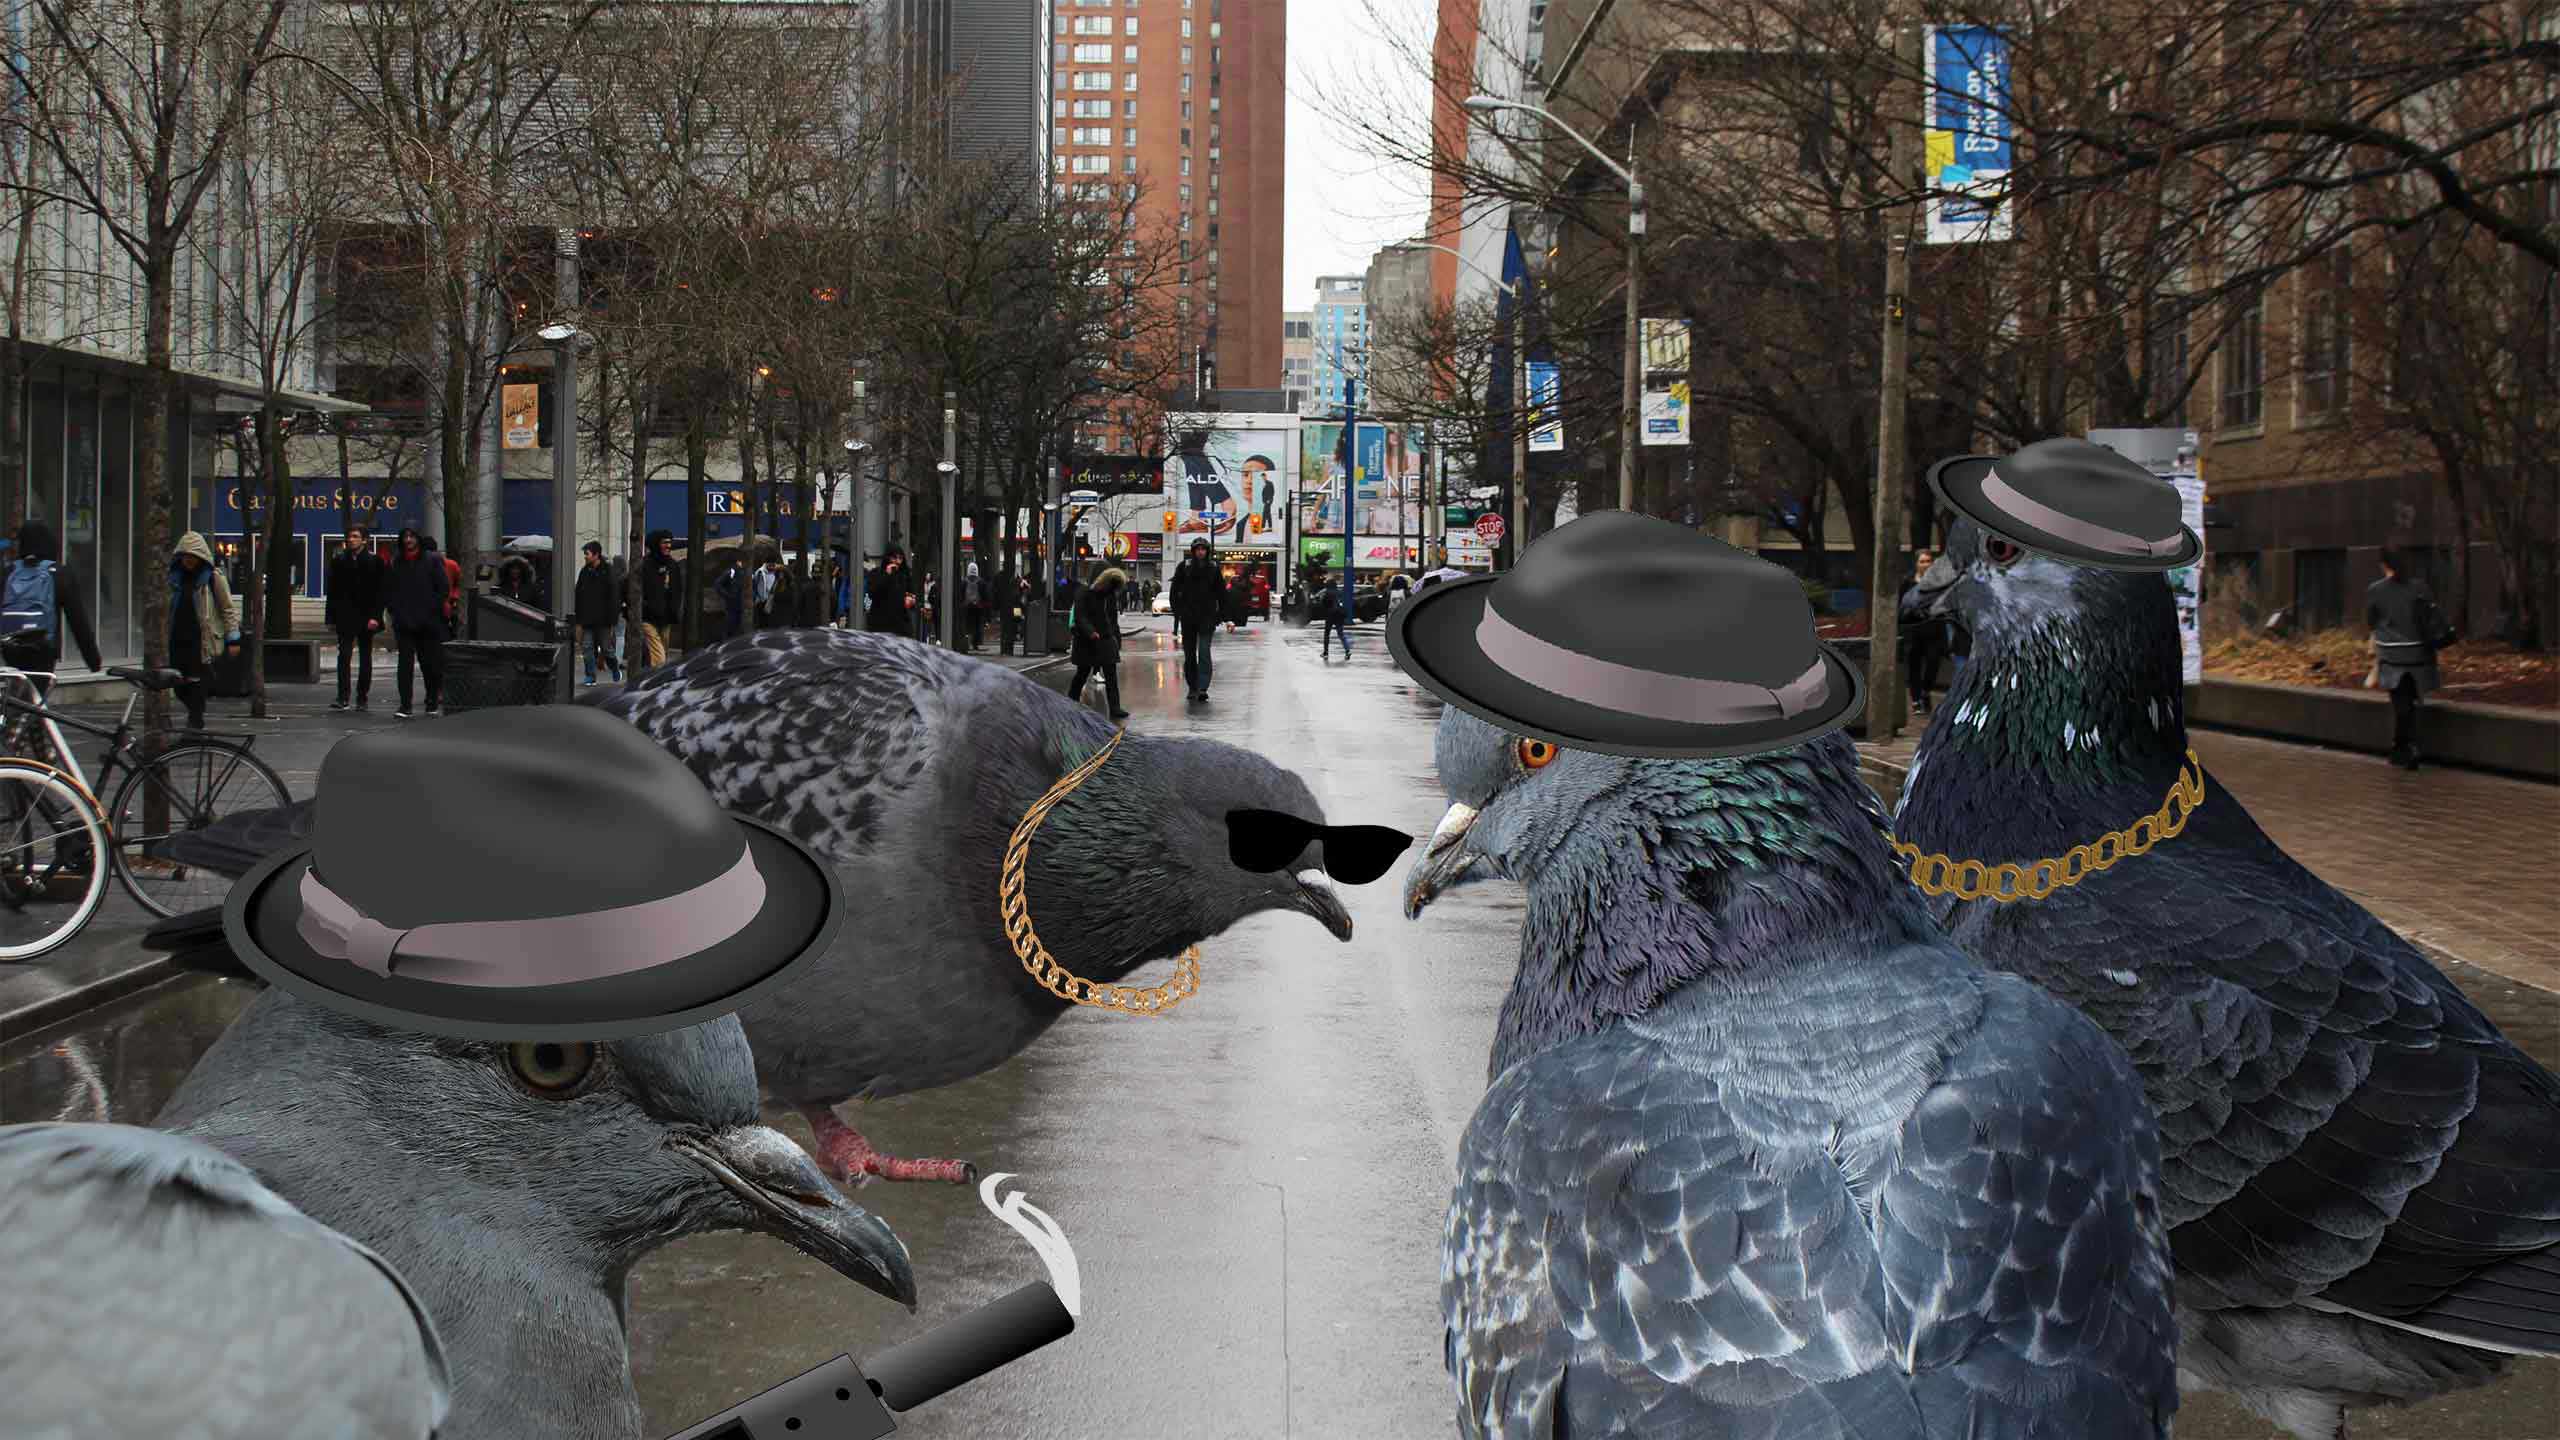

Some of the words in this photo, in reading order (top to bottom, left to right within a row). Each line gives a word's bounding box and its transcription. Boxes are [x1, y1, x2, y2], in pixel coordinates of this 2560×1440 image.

[1186, 474, 1223, 484] ALD
[228, 488, 328, 511] Caus
[1477, 520, 1501, 534] STOP
